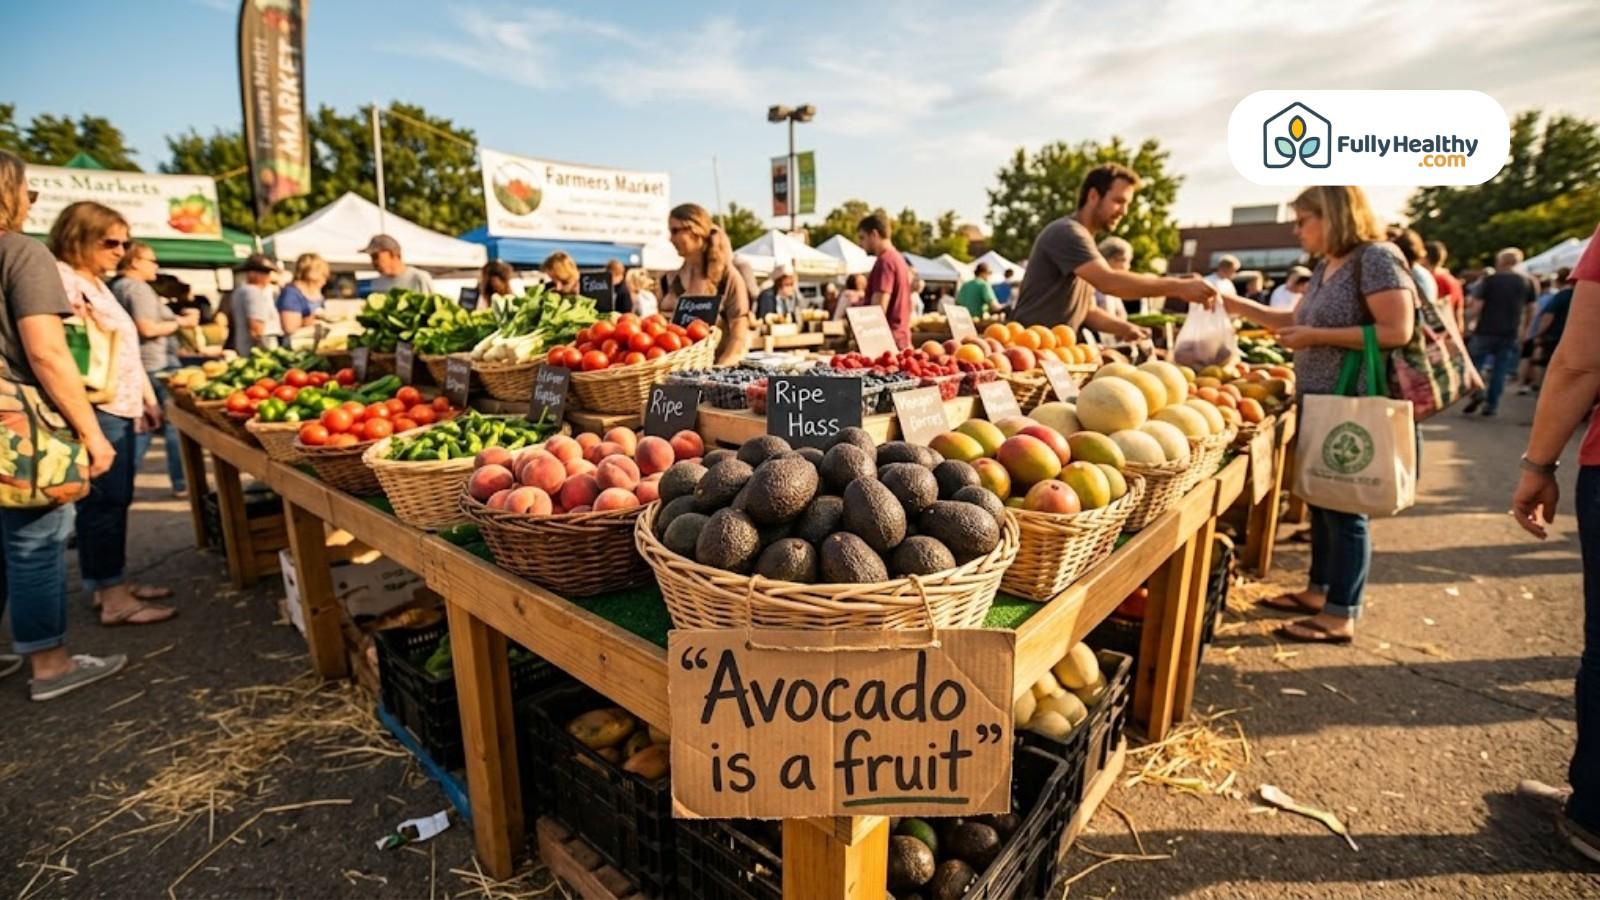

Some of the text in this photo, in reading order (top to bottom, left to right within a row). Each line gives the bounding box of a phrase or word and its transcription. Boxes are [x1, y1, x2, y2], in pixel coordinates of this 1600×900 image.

[277, 36, 301, 158] MARKET
[70, 174, 161, 195] Markets
[546, 166, 665, 197] Farmers Market
[650, 388, 684, 422] Ripe
[774, 380, 826, 411] Ripe
[788, 412, 841, 438] Hass
[711, 743, 756, 792] is
[780, 754, 816, 790] a
